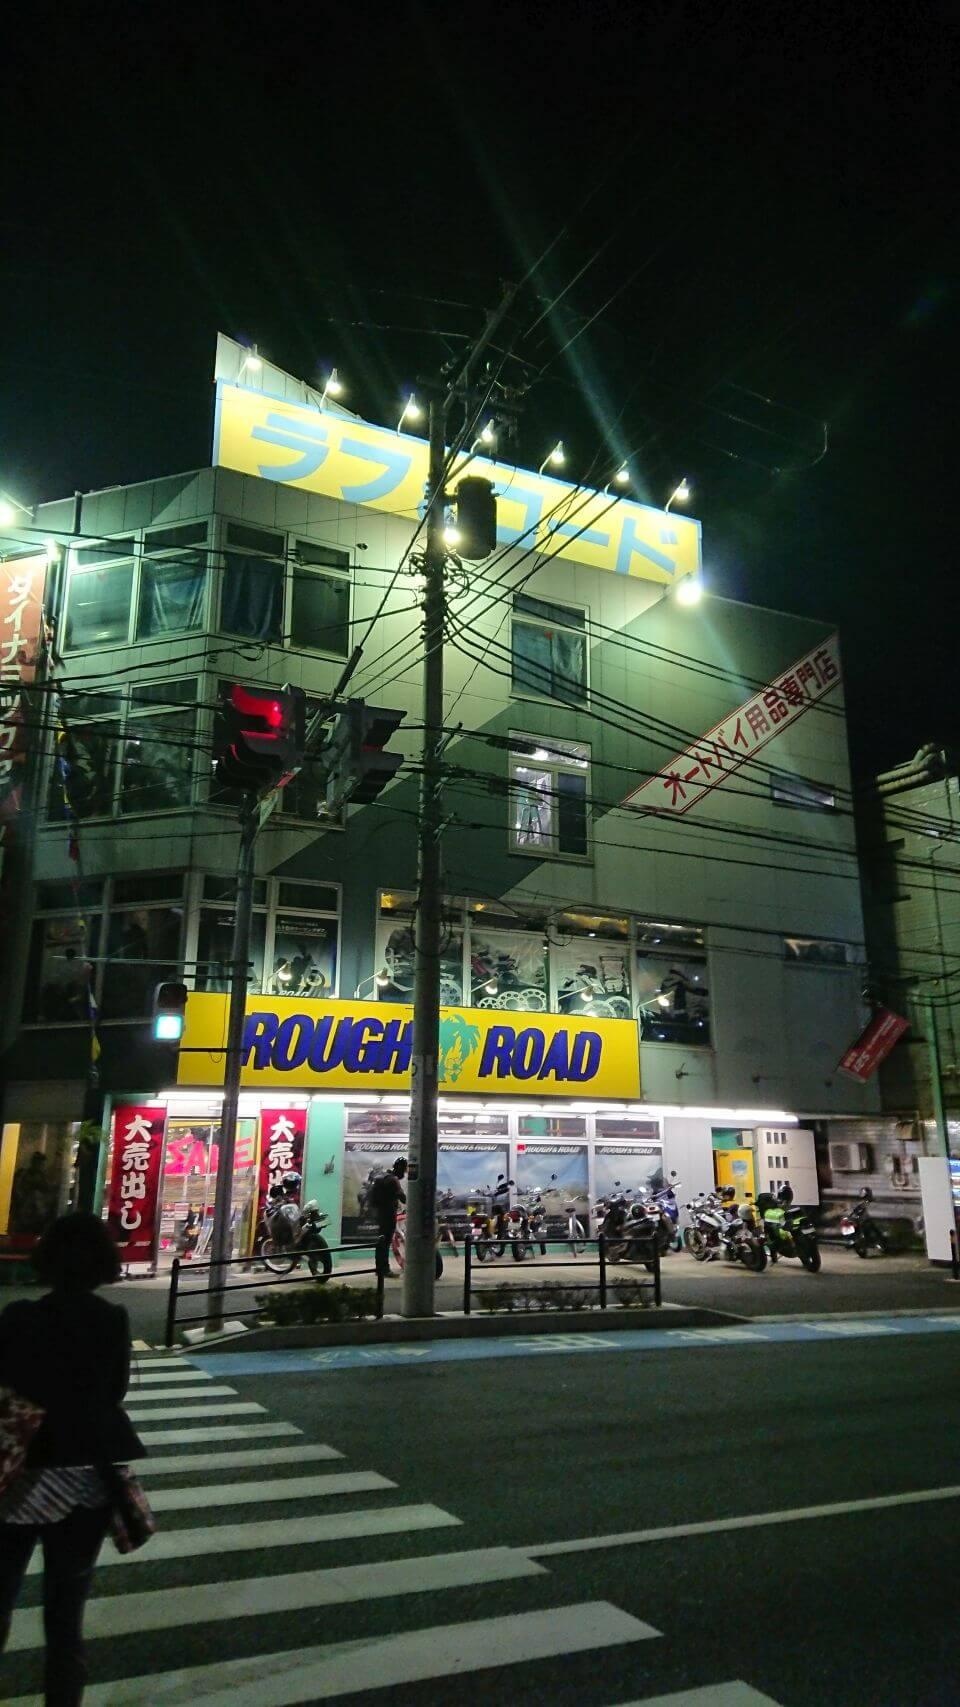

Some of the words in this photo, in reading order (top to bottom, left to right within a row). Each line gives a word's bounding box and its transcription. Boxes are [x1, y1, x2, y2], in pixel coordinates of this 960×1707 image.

[251, 414, 680, 576] ラフロード
[663, 649, 838, 806] オートバイ用品専門店
[240, 1012, 414, 1074] ROUGH
[478, 1026, 603, 1082] ROAD
[121, 1114, 152, 1230] 大売出し
